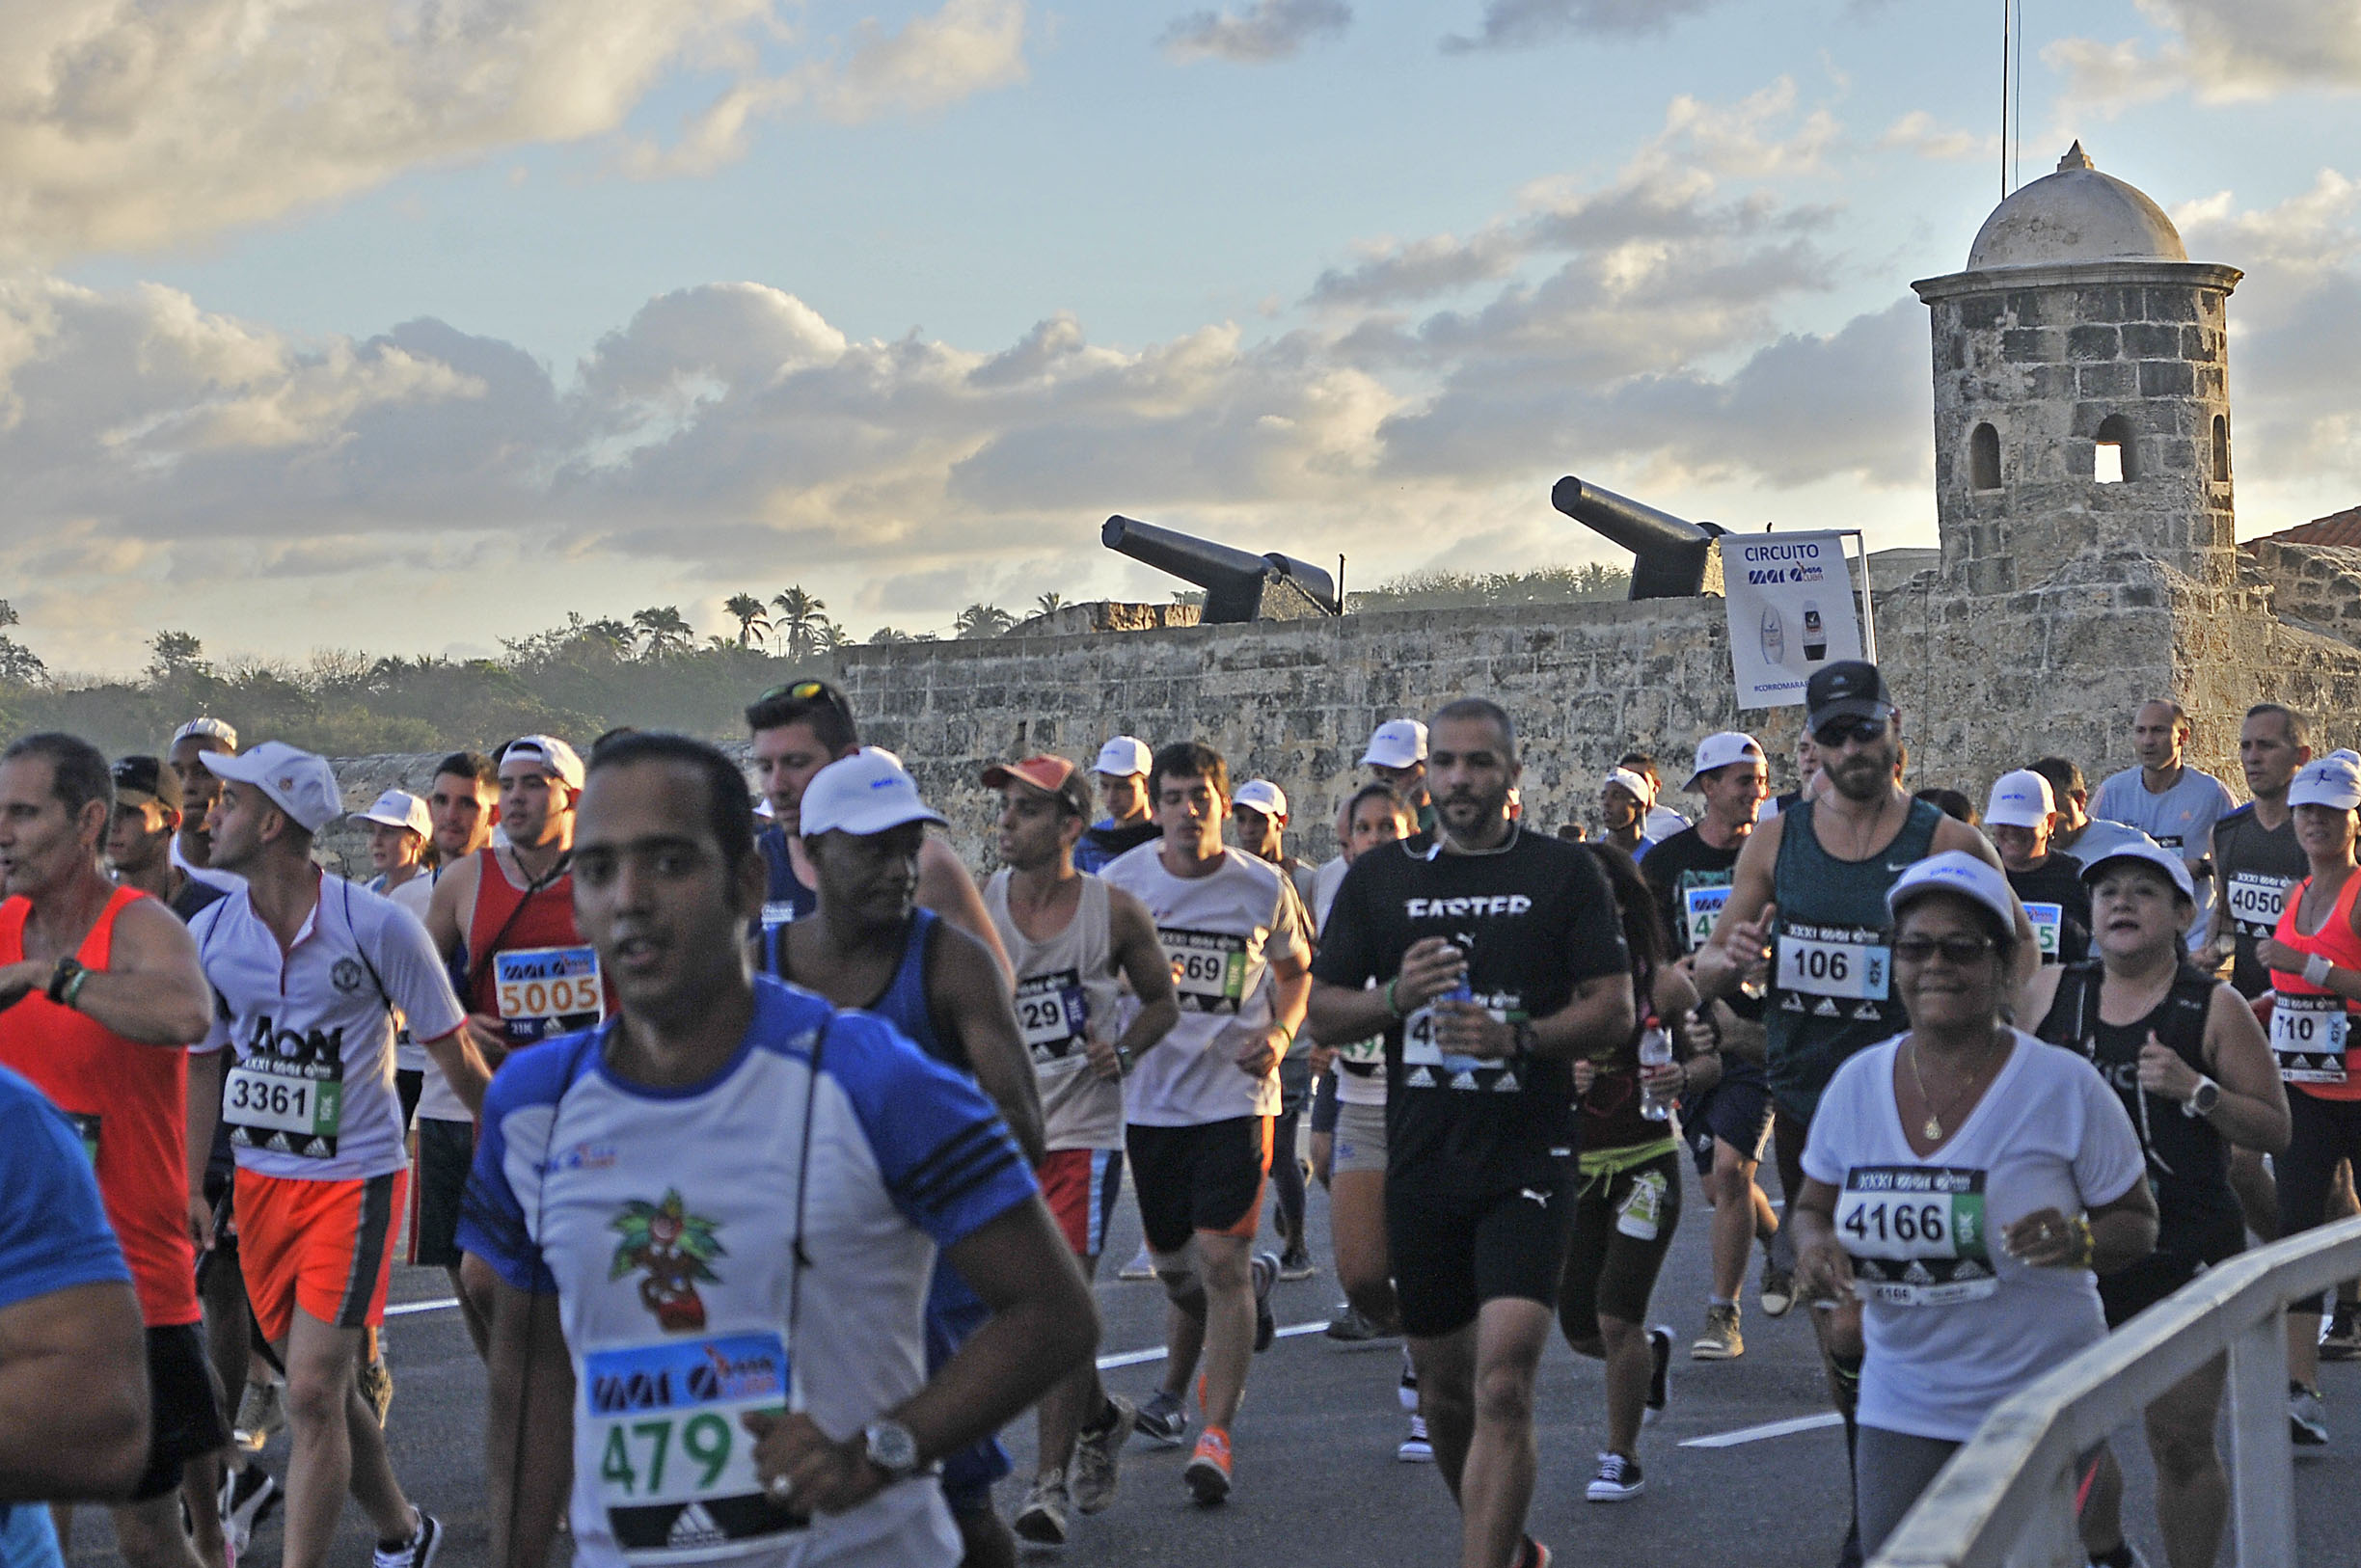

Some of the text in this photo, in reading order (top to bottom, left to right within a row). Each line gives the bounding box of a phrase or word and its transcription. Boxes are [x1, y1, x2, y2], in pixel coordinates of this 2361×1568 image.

[1745, 544, 1819, 561] CIRCUITO
[2233, 888, 2281, 915] 4050
[1795, 949, 1848, 981] 106
[502, 978, 598, 1016] 5005
[2278, 1014, 2314, 1041] 710
[231, 1079, 306, 1118] 3361
[1845, 1203, 1945, 1242] 4166
[600, 1406, 788, 1494] 479
